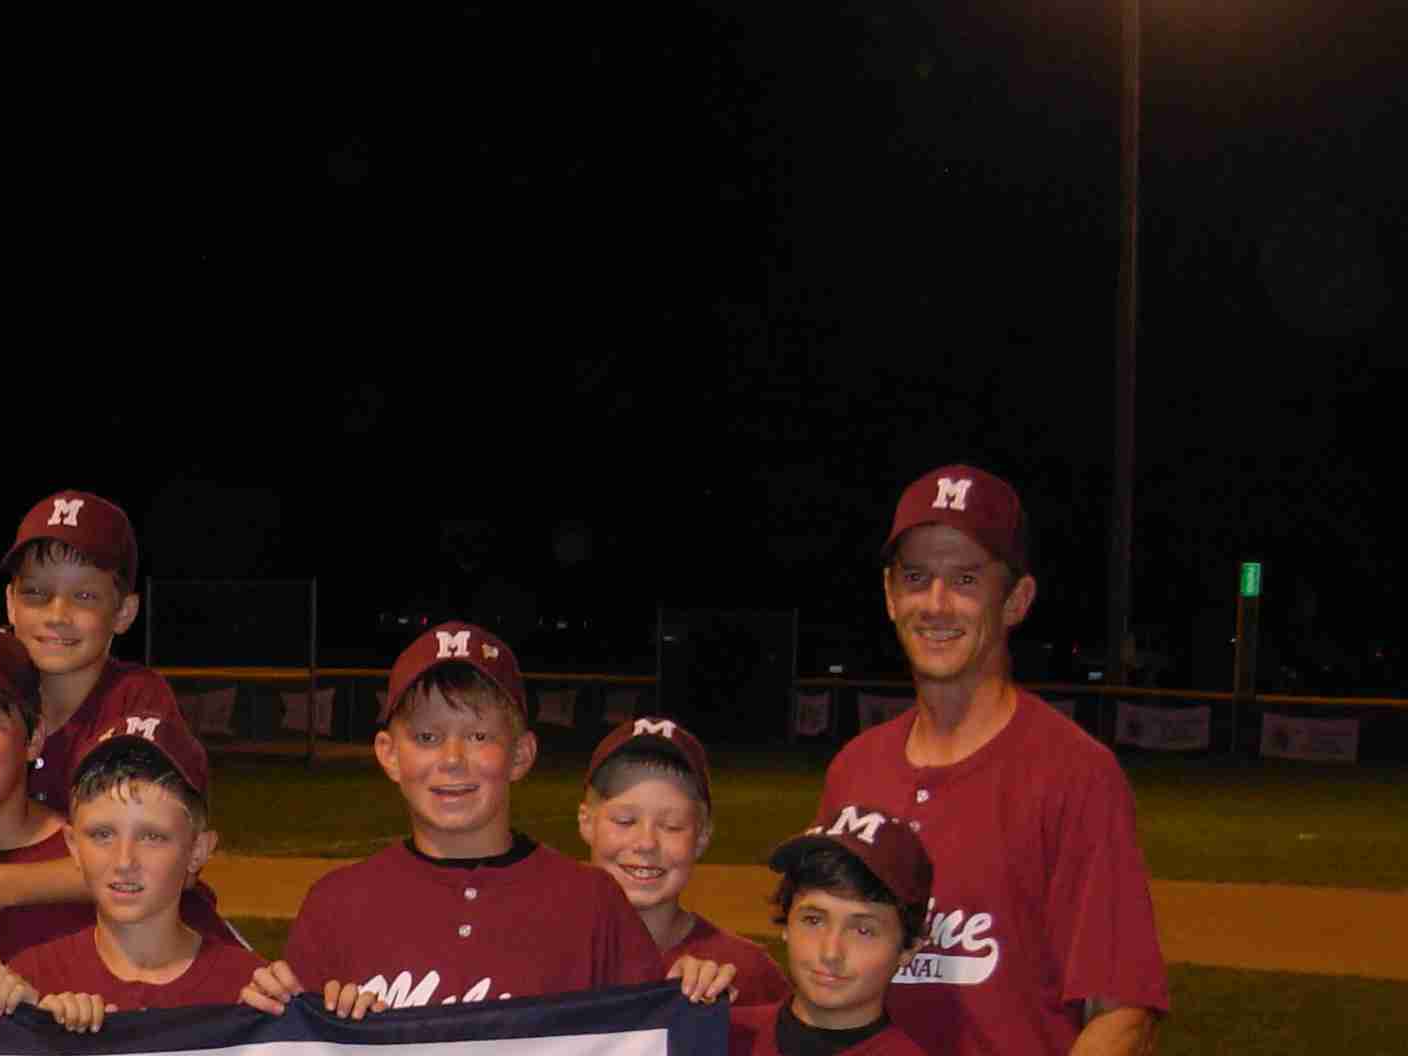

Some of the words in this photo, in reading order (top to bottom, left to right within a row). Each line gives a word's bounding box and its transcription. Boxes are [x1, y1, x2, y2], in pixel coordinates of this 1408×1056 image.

[933, 477, 971, 510] M
[48, 498, 84, 526] M
[436, 630, 471, 658] M
[127, 717, 160, 741] M
[633, 718, 676, 738] M
[826, 805, 886, 843] M
